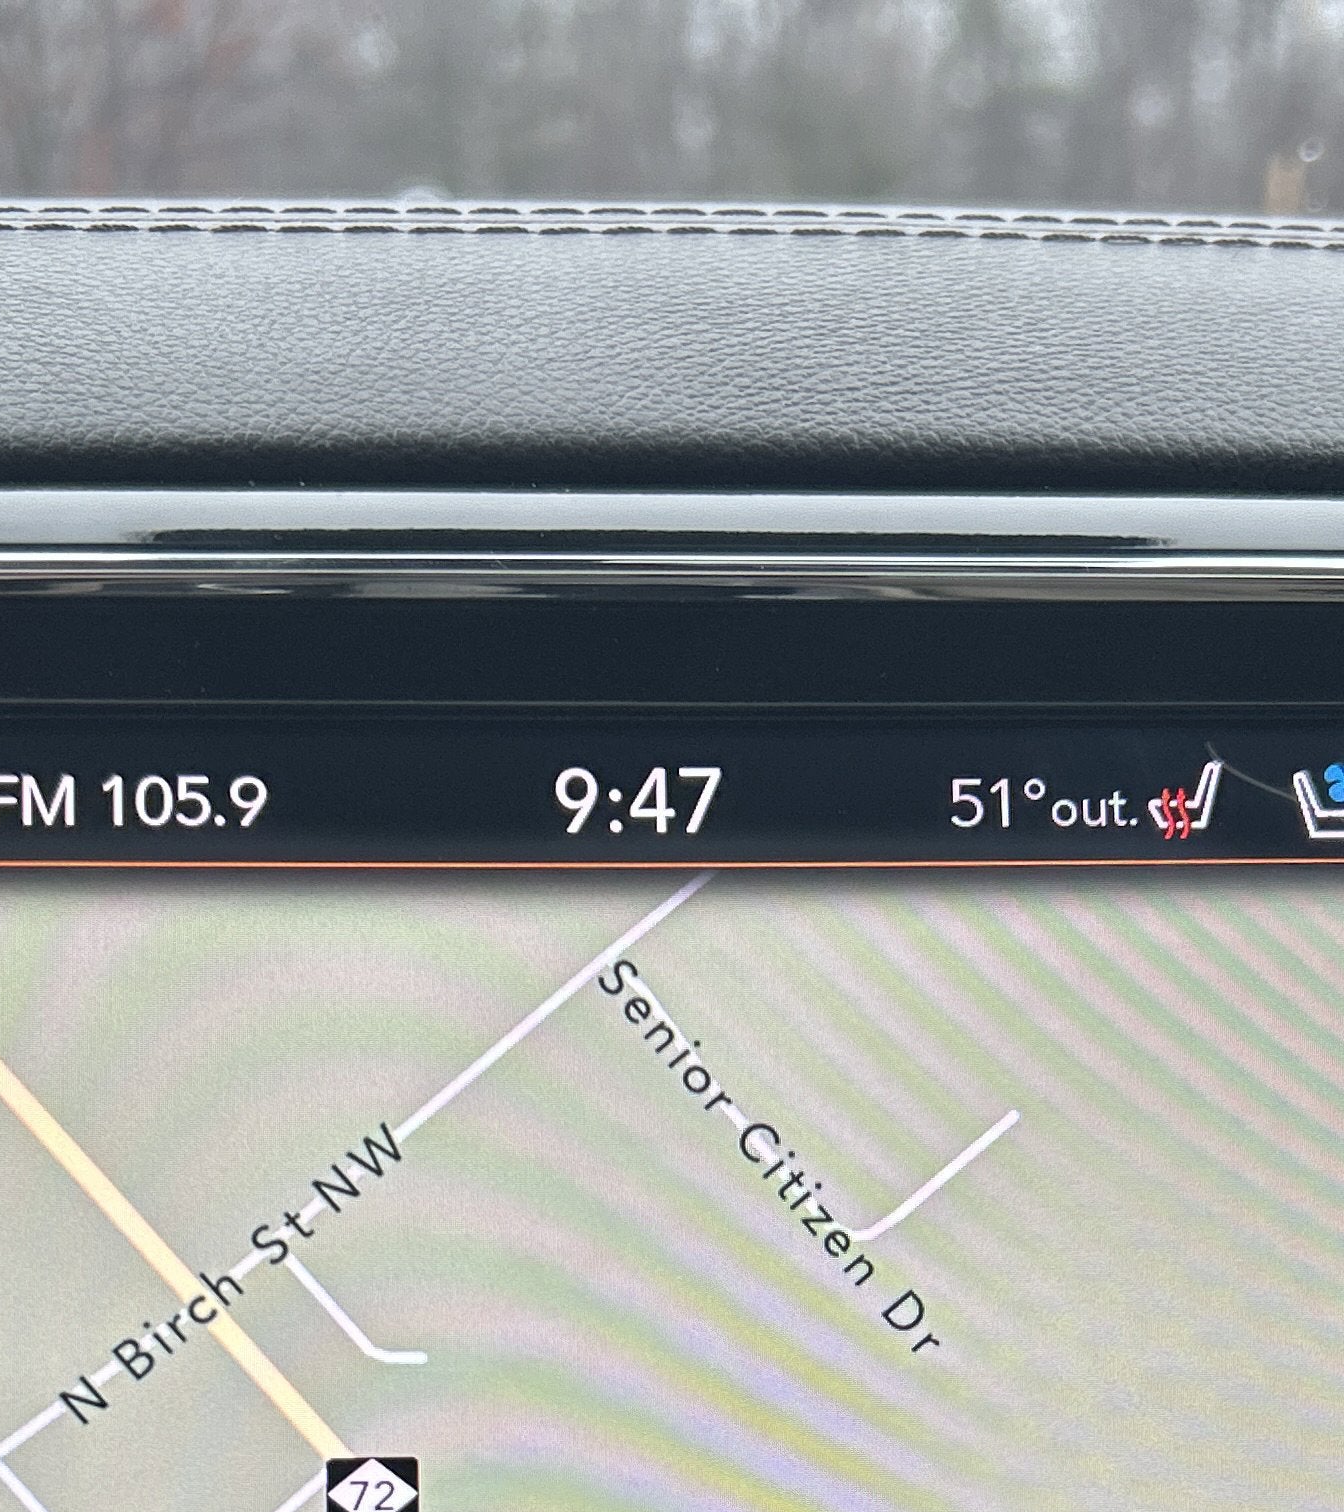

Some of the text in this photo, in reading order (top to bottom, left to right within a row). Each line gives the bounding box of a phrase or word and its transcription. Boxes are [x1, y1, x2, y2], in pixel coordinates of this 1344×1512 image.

[101, 775, 268, 828] 105.9
[556, 767, 723, 834] 9:47
[598, 960, 941, 1357] Senior Citizen Dr
[59, 1122, 404, 1424] N Birch St NW
[349, 1480, 396, 1512] 72
